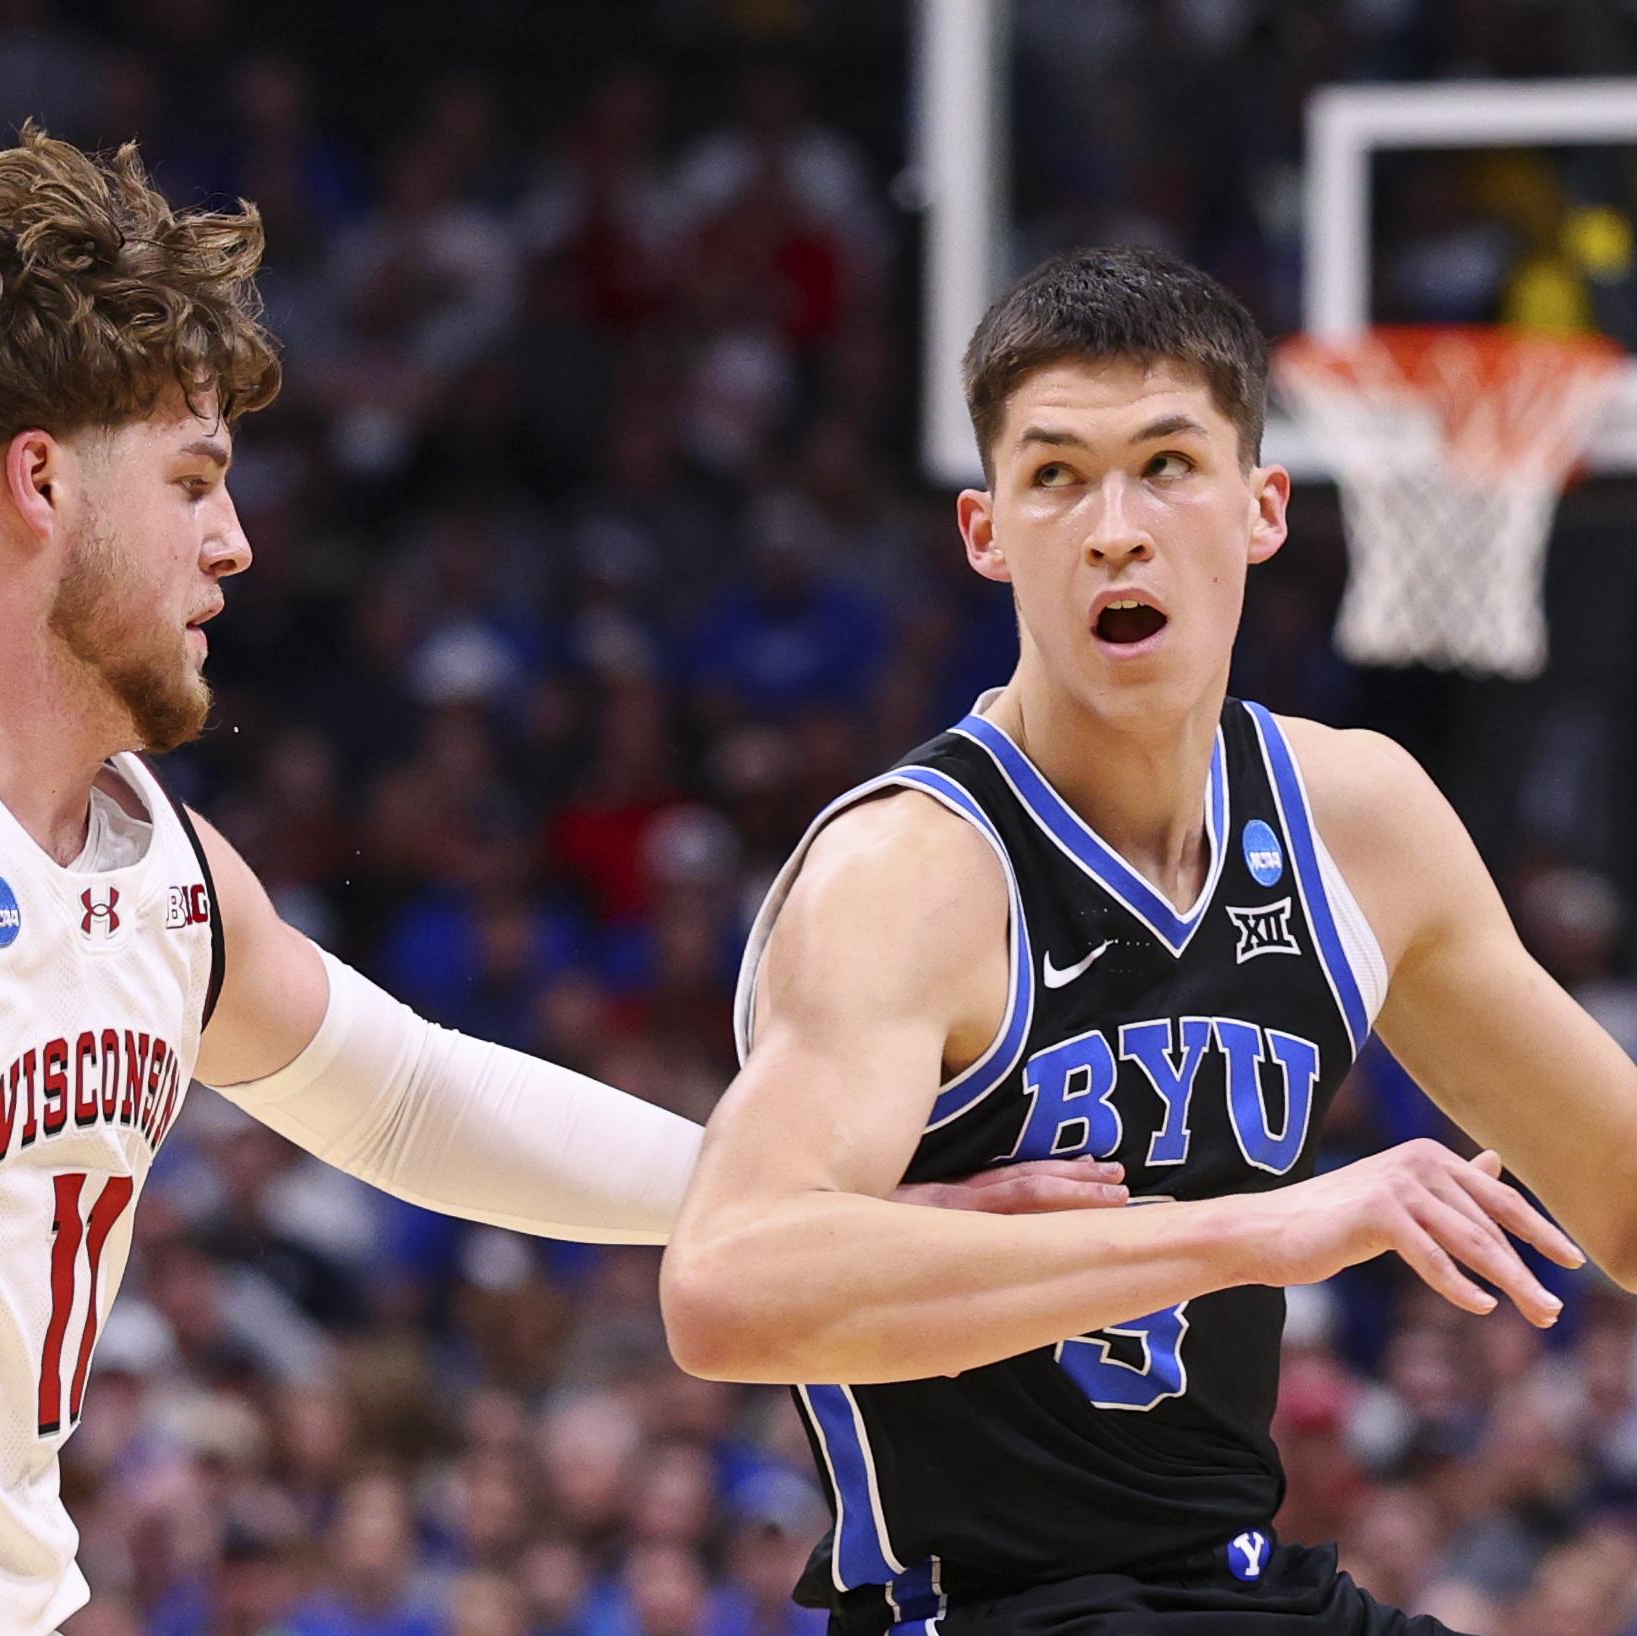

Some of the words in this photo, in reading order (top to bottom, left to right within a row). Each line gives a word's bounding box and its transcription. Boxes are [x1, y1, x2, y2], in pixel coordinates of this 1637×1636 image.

[991, 1015, 1321, 1176] BYU
[38, 1173, 134, 1438] 11
[1232, 1530, 1266, 1577] Y
